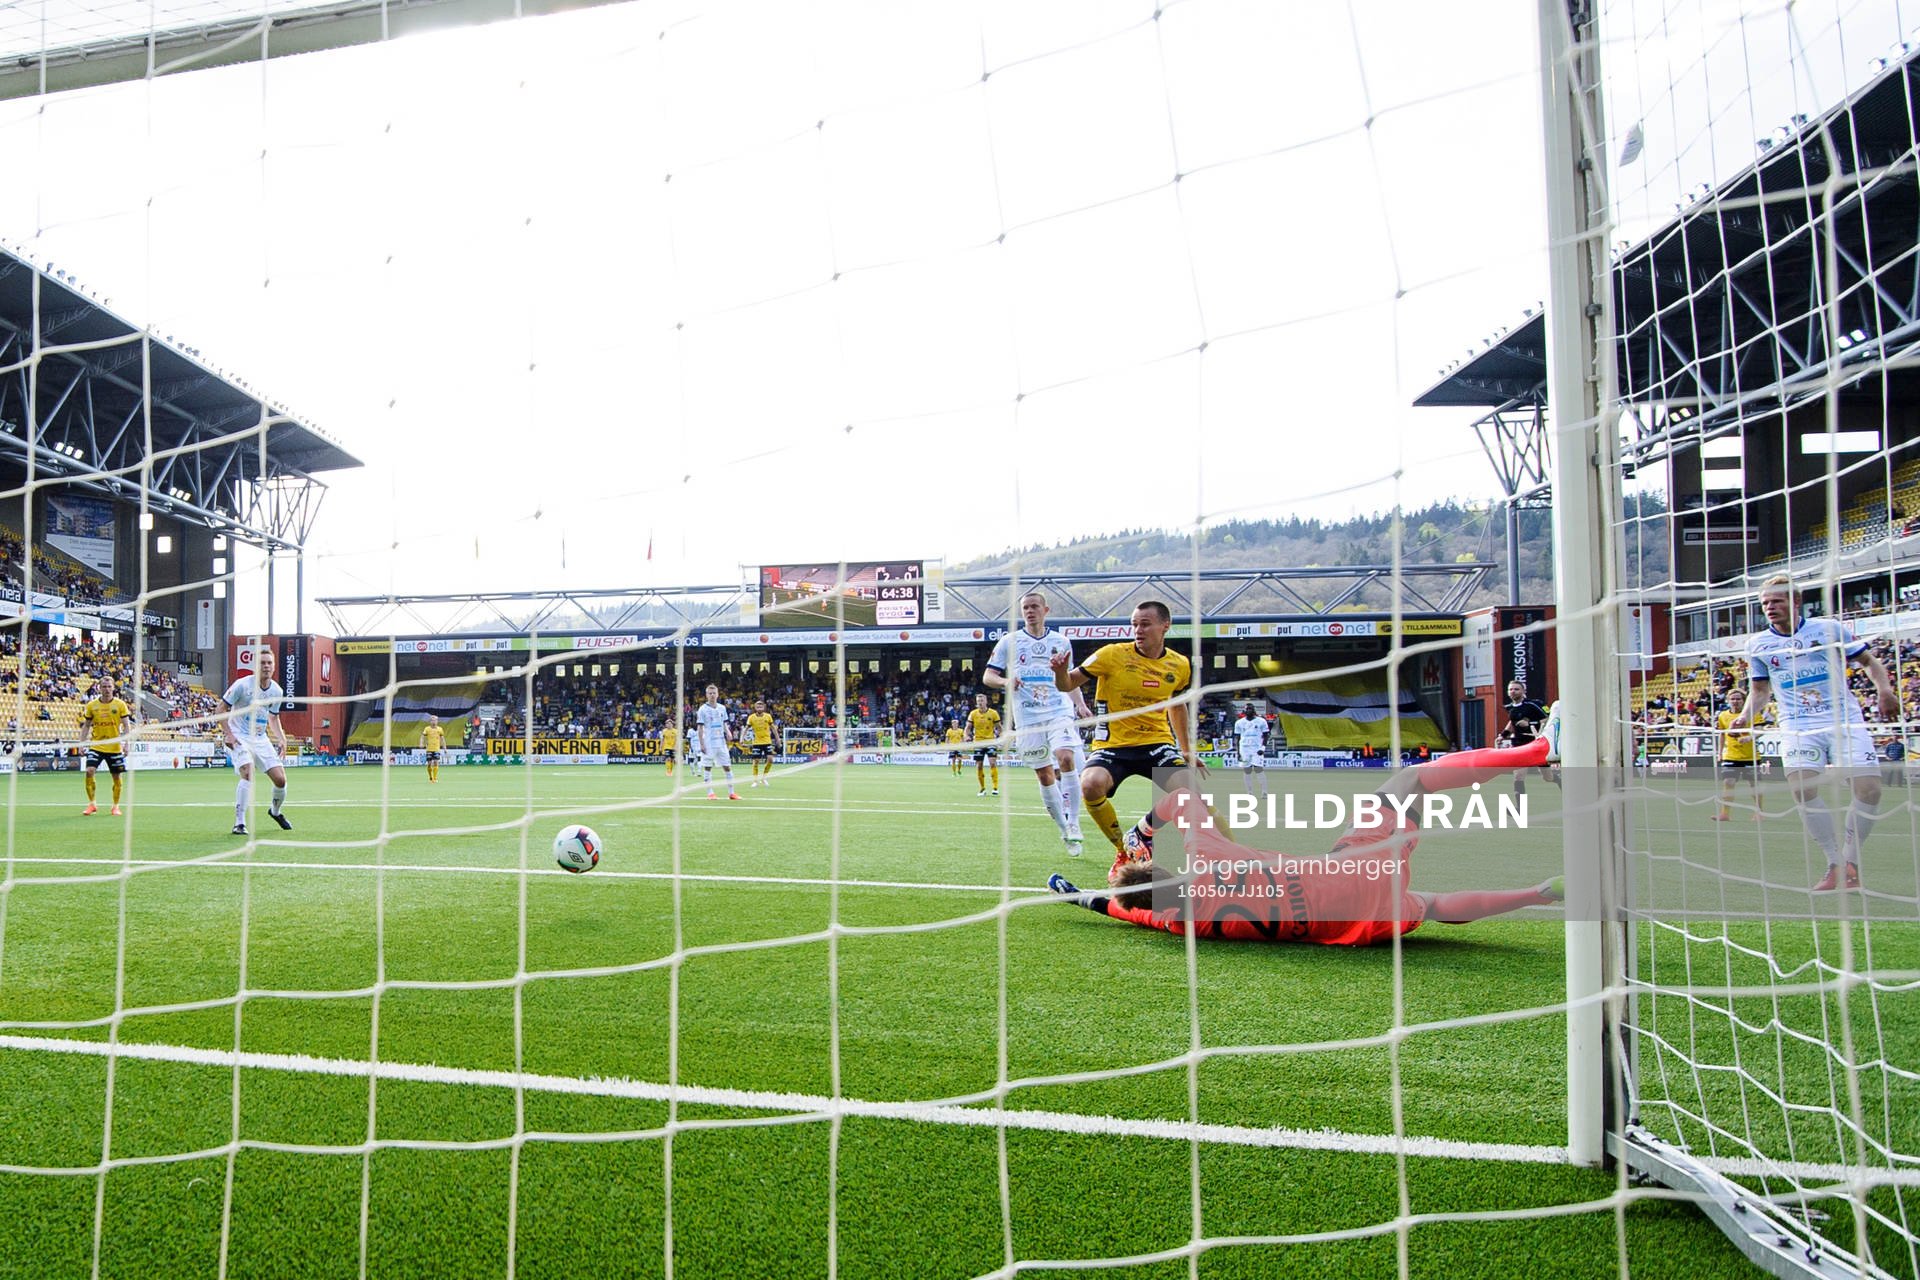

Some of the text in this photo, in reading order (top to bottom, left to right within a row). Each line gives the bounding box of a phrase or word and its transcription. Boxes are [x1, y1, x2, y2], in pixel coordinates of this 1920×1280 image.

[881, 587, 914, 599] 64:38
[1064, 626, 1132, 639] PULSEN
[1236, 626, 1251, 636] put
[1277, 625, 1291, 636] put
[466, 641, 477, 650] put
[496, 640, 507, 649] put
[577, 636, 634, 648] PULSEN
